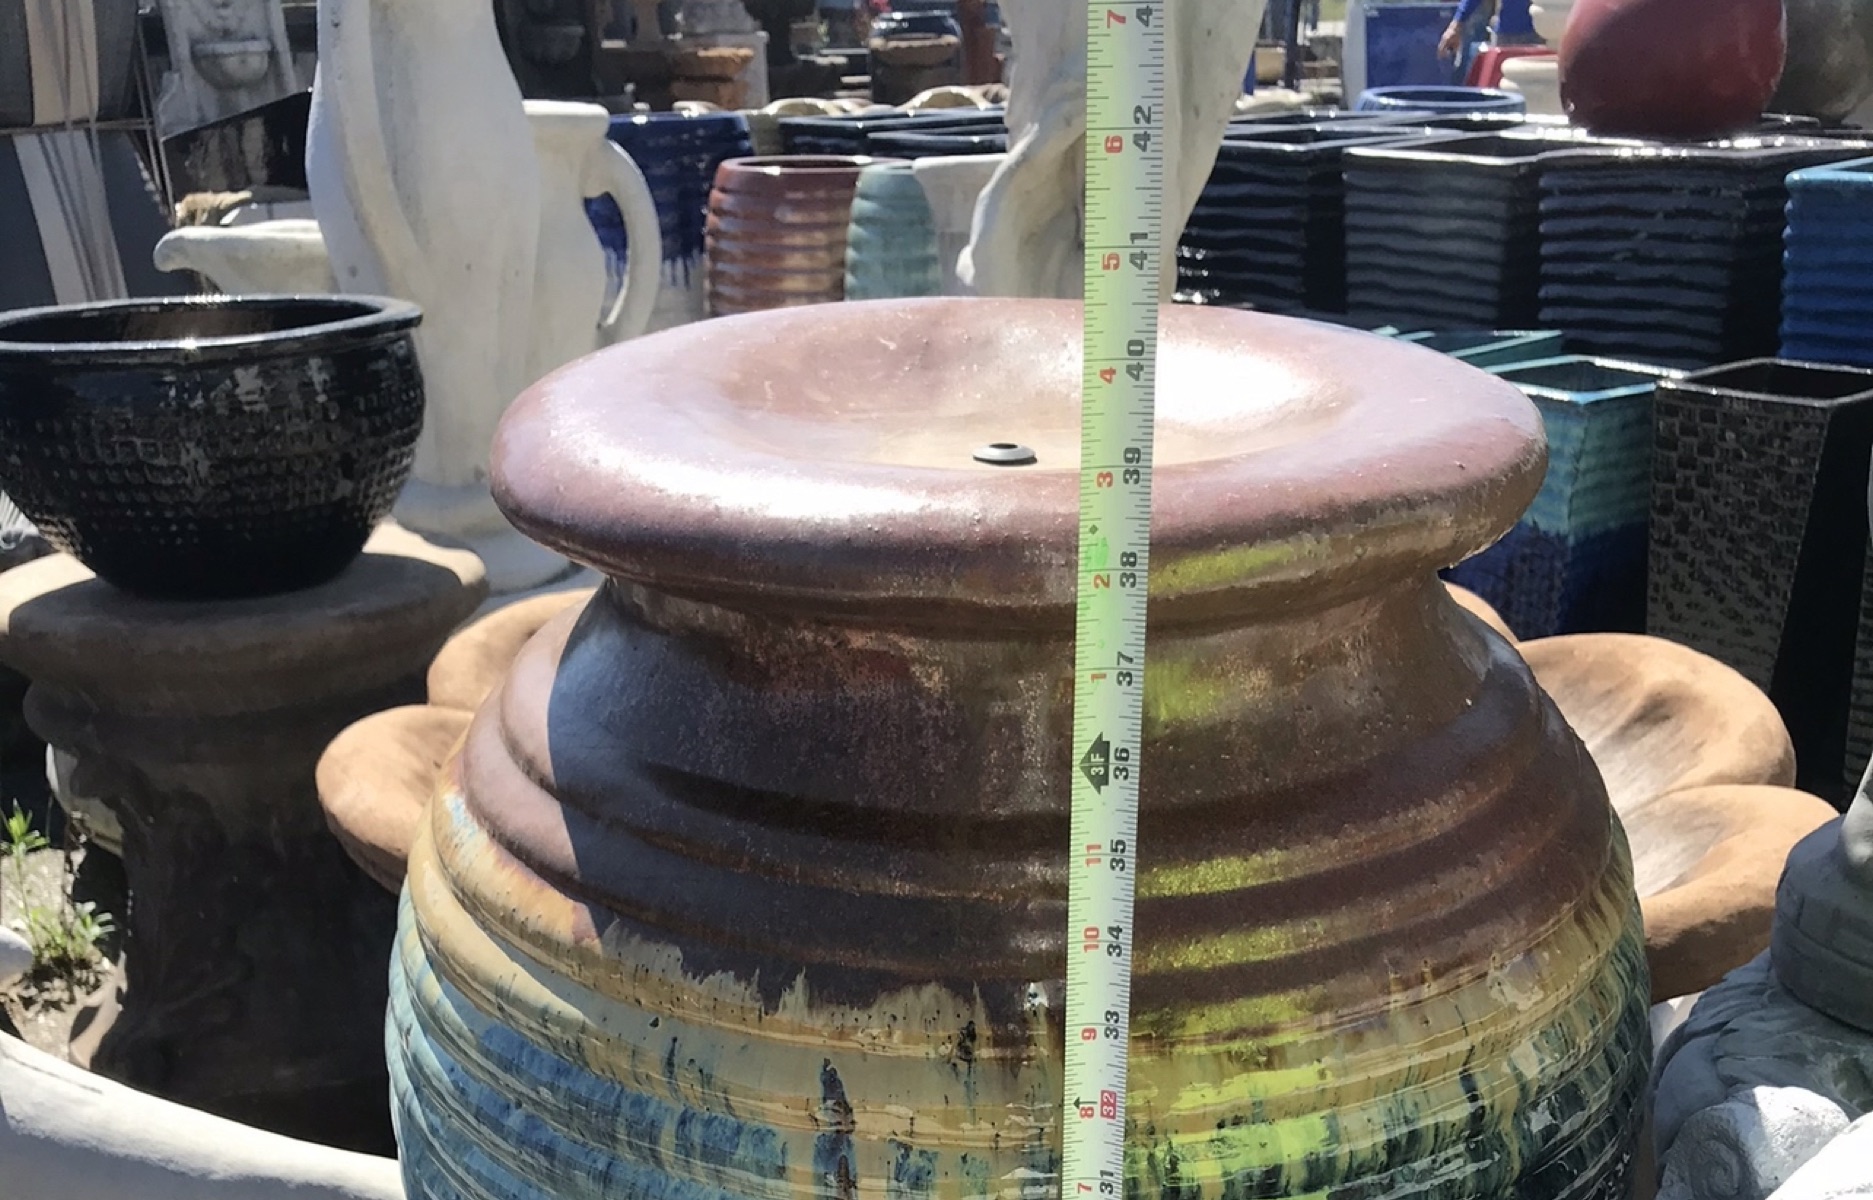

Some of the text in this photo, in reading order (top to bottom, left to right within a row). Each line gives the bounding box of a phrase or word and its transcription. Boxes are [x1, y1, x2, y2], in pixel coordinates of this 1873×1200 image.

[1107, 10, 1126, 28] 7
[1136, 6, 1152, 27] 4
[1133, 105, 1151, 152] 42
[1105, 135, 1123, 153] 6
[1103, 253, 1119, 270] 5
[1129, 232, 1148, 270] 41
[1126, 340, 1144, 381] 40
[1100, 367, 1116, 383] 4
[1123, 448, 1141, 485] 39
[1097, 471, 1113, 488] 3
[1094, 574, 1110, 588] 2
[1120, 551, 1138, 588] 38
[1091, 673, 1107, 683] 1
[1117, 651, 1133, 686] 37
[1091, 753, 1104, 775] 3F
[1114, 747, 1130, 780] 36
[1085, 844, 1101, 867] 11
[1110, 839, 1126, 871] 35
[1084, 927, 1099, 952] 10
[1107, 925, 1122, 957] 34
[1082, 1028, 1096, 1040] 9
[1104, 1010, 1119, 1039] 33
[1080, 1106, 1094, 1118] 8
[1102, 1091, 1116, 1115] 32
[1078, 1182, 1092, 1193] 7
[1100, 1169, 1114, 1194] 31
